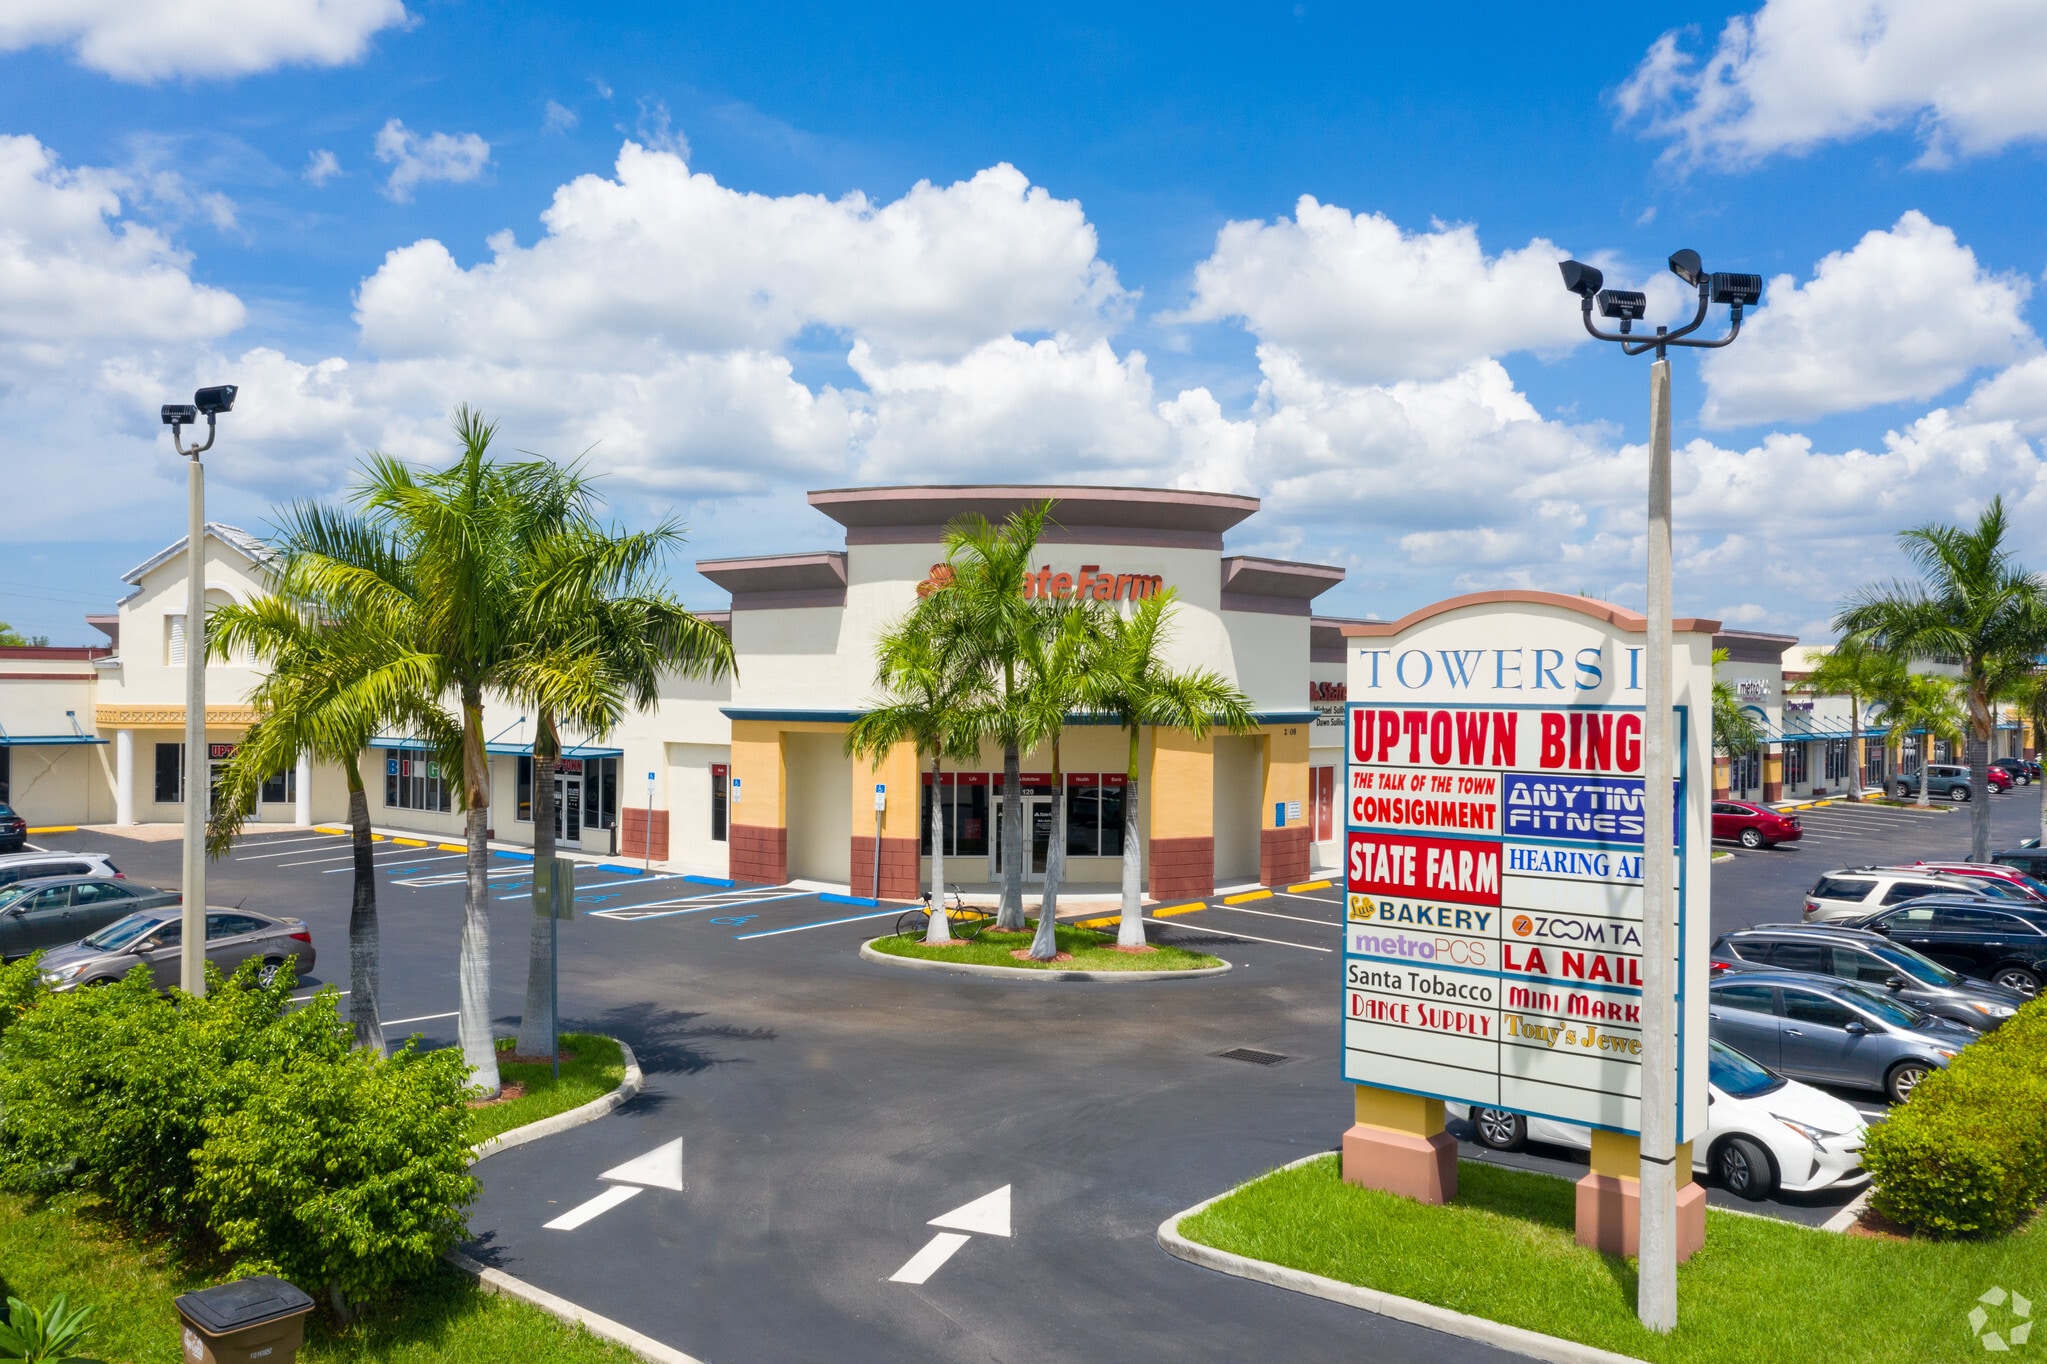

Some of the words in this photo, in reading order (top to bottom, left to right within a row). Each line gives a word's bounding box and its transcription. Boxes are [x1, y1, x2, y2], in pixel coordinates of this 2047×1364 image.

[1360, 646, 1603, 692] TOWERS
[1354, 709, 1518, 767] UPTOWN
[1539, 712, 1645, 773] BING
[1022, 788, 1035, 796] 120
[1353, 772, 1374, 789] THE
[1378, 773, 1406, 791] TALK
[1410, 774, 1427, 792] OF
[1431, 775, 1453, 793] THE
[1458, 776, 1496, 795] TOWN
[1508, 782, 1645, 812] ANYTIM
[1353, 796, 1497, 830] CONSIGNMENT
[1510, 809, 1644, 836] FITNES
[1350, 841, 1417, 886] STATE
[1426, 848, 1499, 895] FARM
[1509, 848, 1610, 877] HEARING
[1616, 855, 1644, 879] AI
[1350, 896, 1376, 919] Luis
[1379, 901, 1492, 932] BAKERY
[1535, 916, 1605, 944] ZOOM
[1610, 924, 1642, 948] TA
[1356, 934, 1486, 966] metroPCS
[1504, 944, 1548, 975] LA
[1562, 951, 1643, 987] NAIL
[1349, 964, 1402, 990] Santa
[1408, 972, 1492, 1002] Tobacco
[1352, 993, 1409, 1025] DANCE
[1417, 1003, 1491, 1037] SUPPLY
[1567, 993, 1640, 1024] MARK
[1504, 1013, 1576, 1049] Tony's
[1581, 1025, 1643, 1056] Jewe
